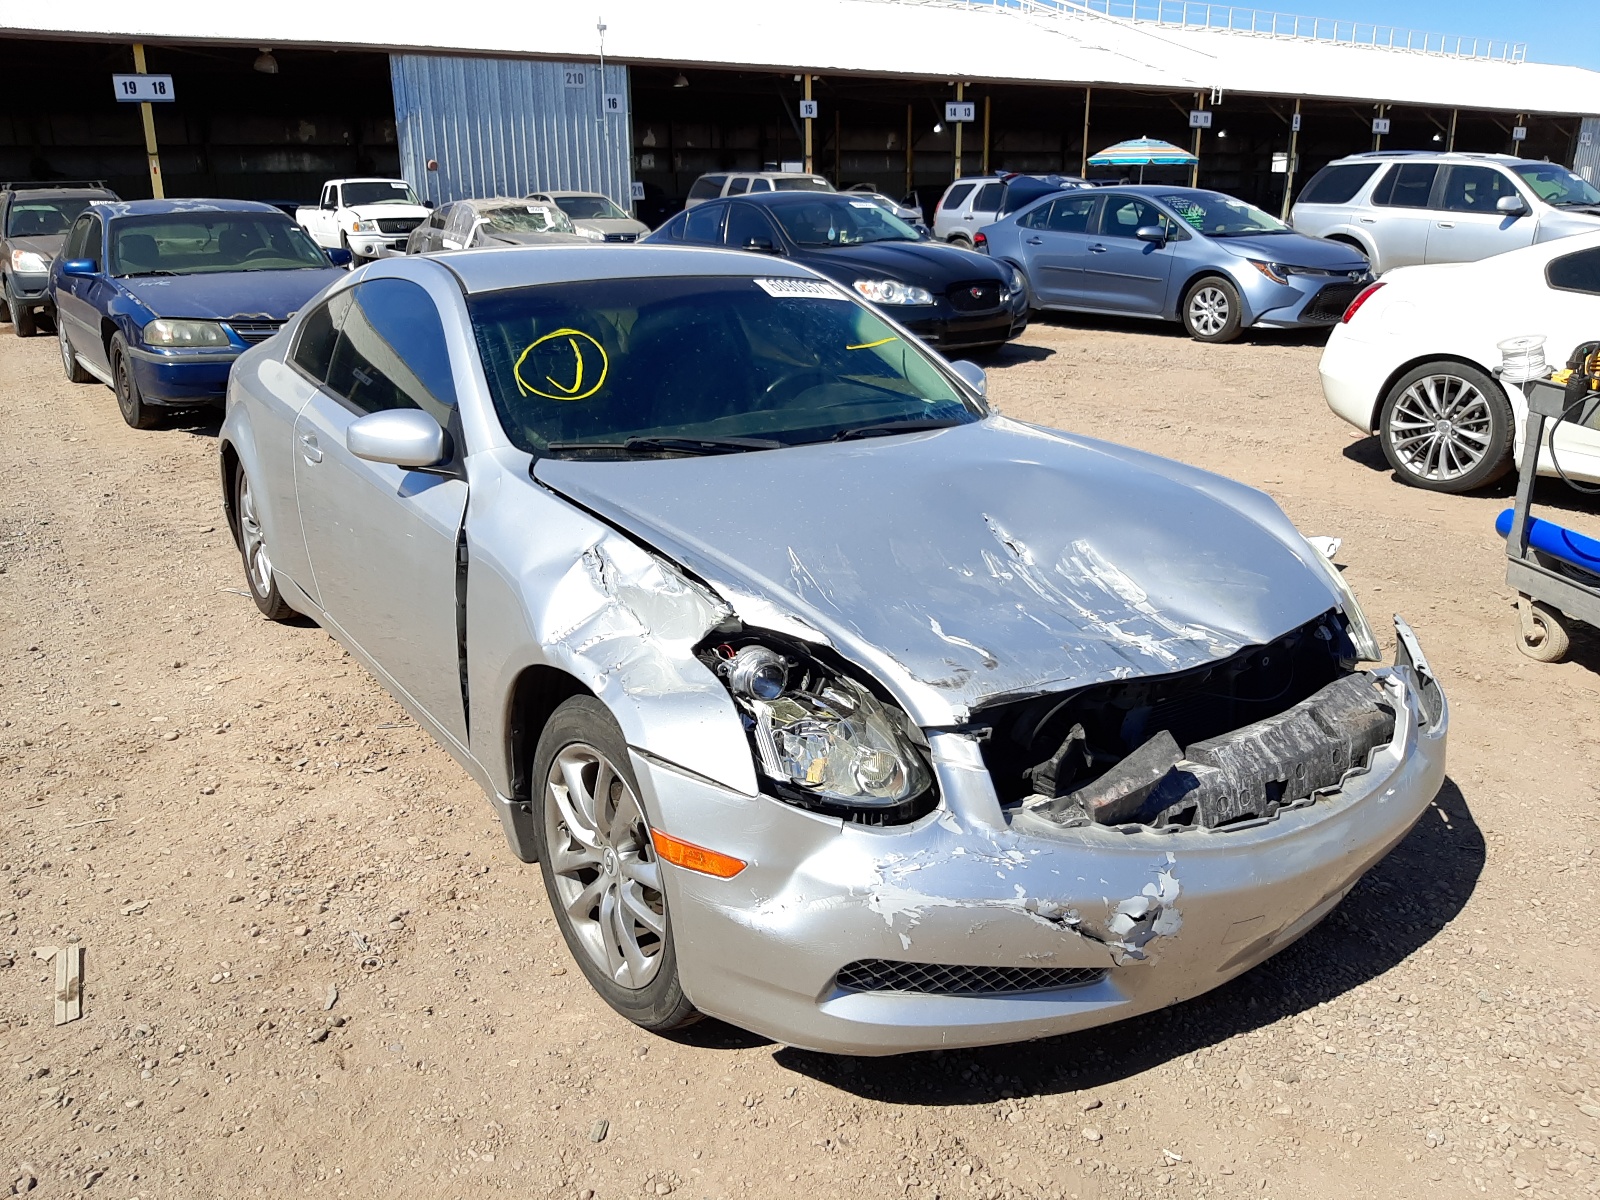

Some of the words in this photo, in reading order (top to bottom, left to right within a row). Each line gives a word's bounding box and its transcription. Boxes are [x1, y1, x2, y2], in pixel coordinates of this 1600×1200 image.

[565, 72, 584, 85] 210
[121, 80, 138, 95] 19
[151, 81, 167, 95] 18
[607, 97, 618, 109] 16
[804, 103, 813, 115] 15
[950, 107, 957, 117] 14
[963, 107, 971, 117] 13
